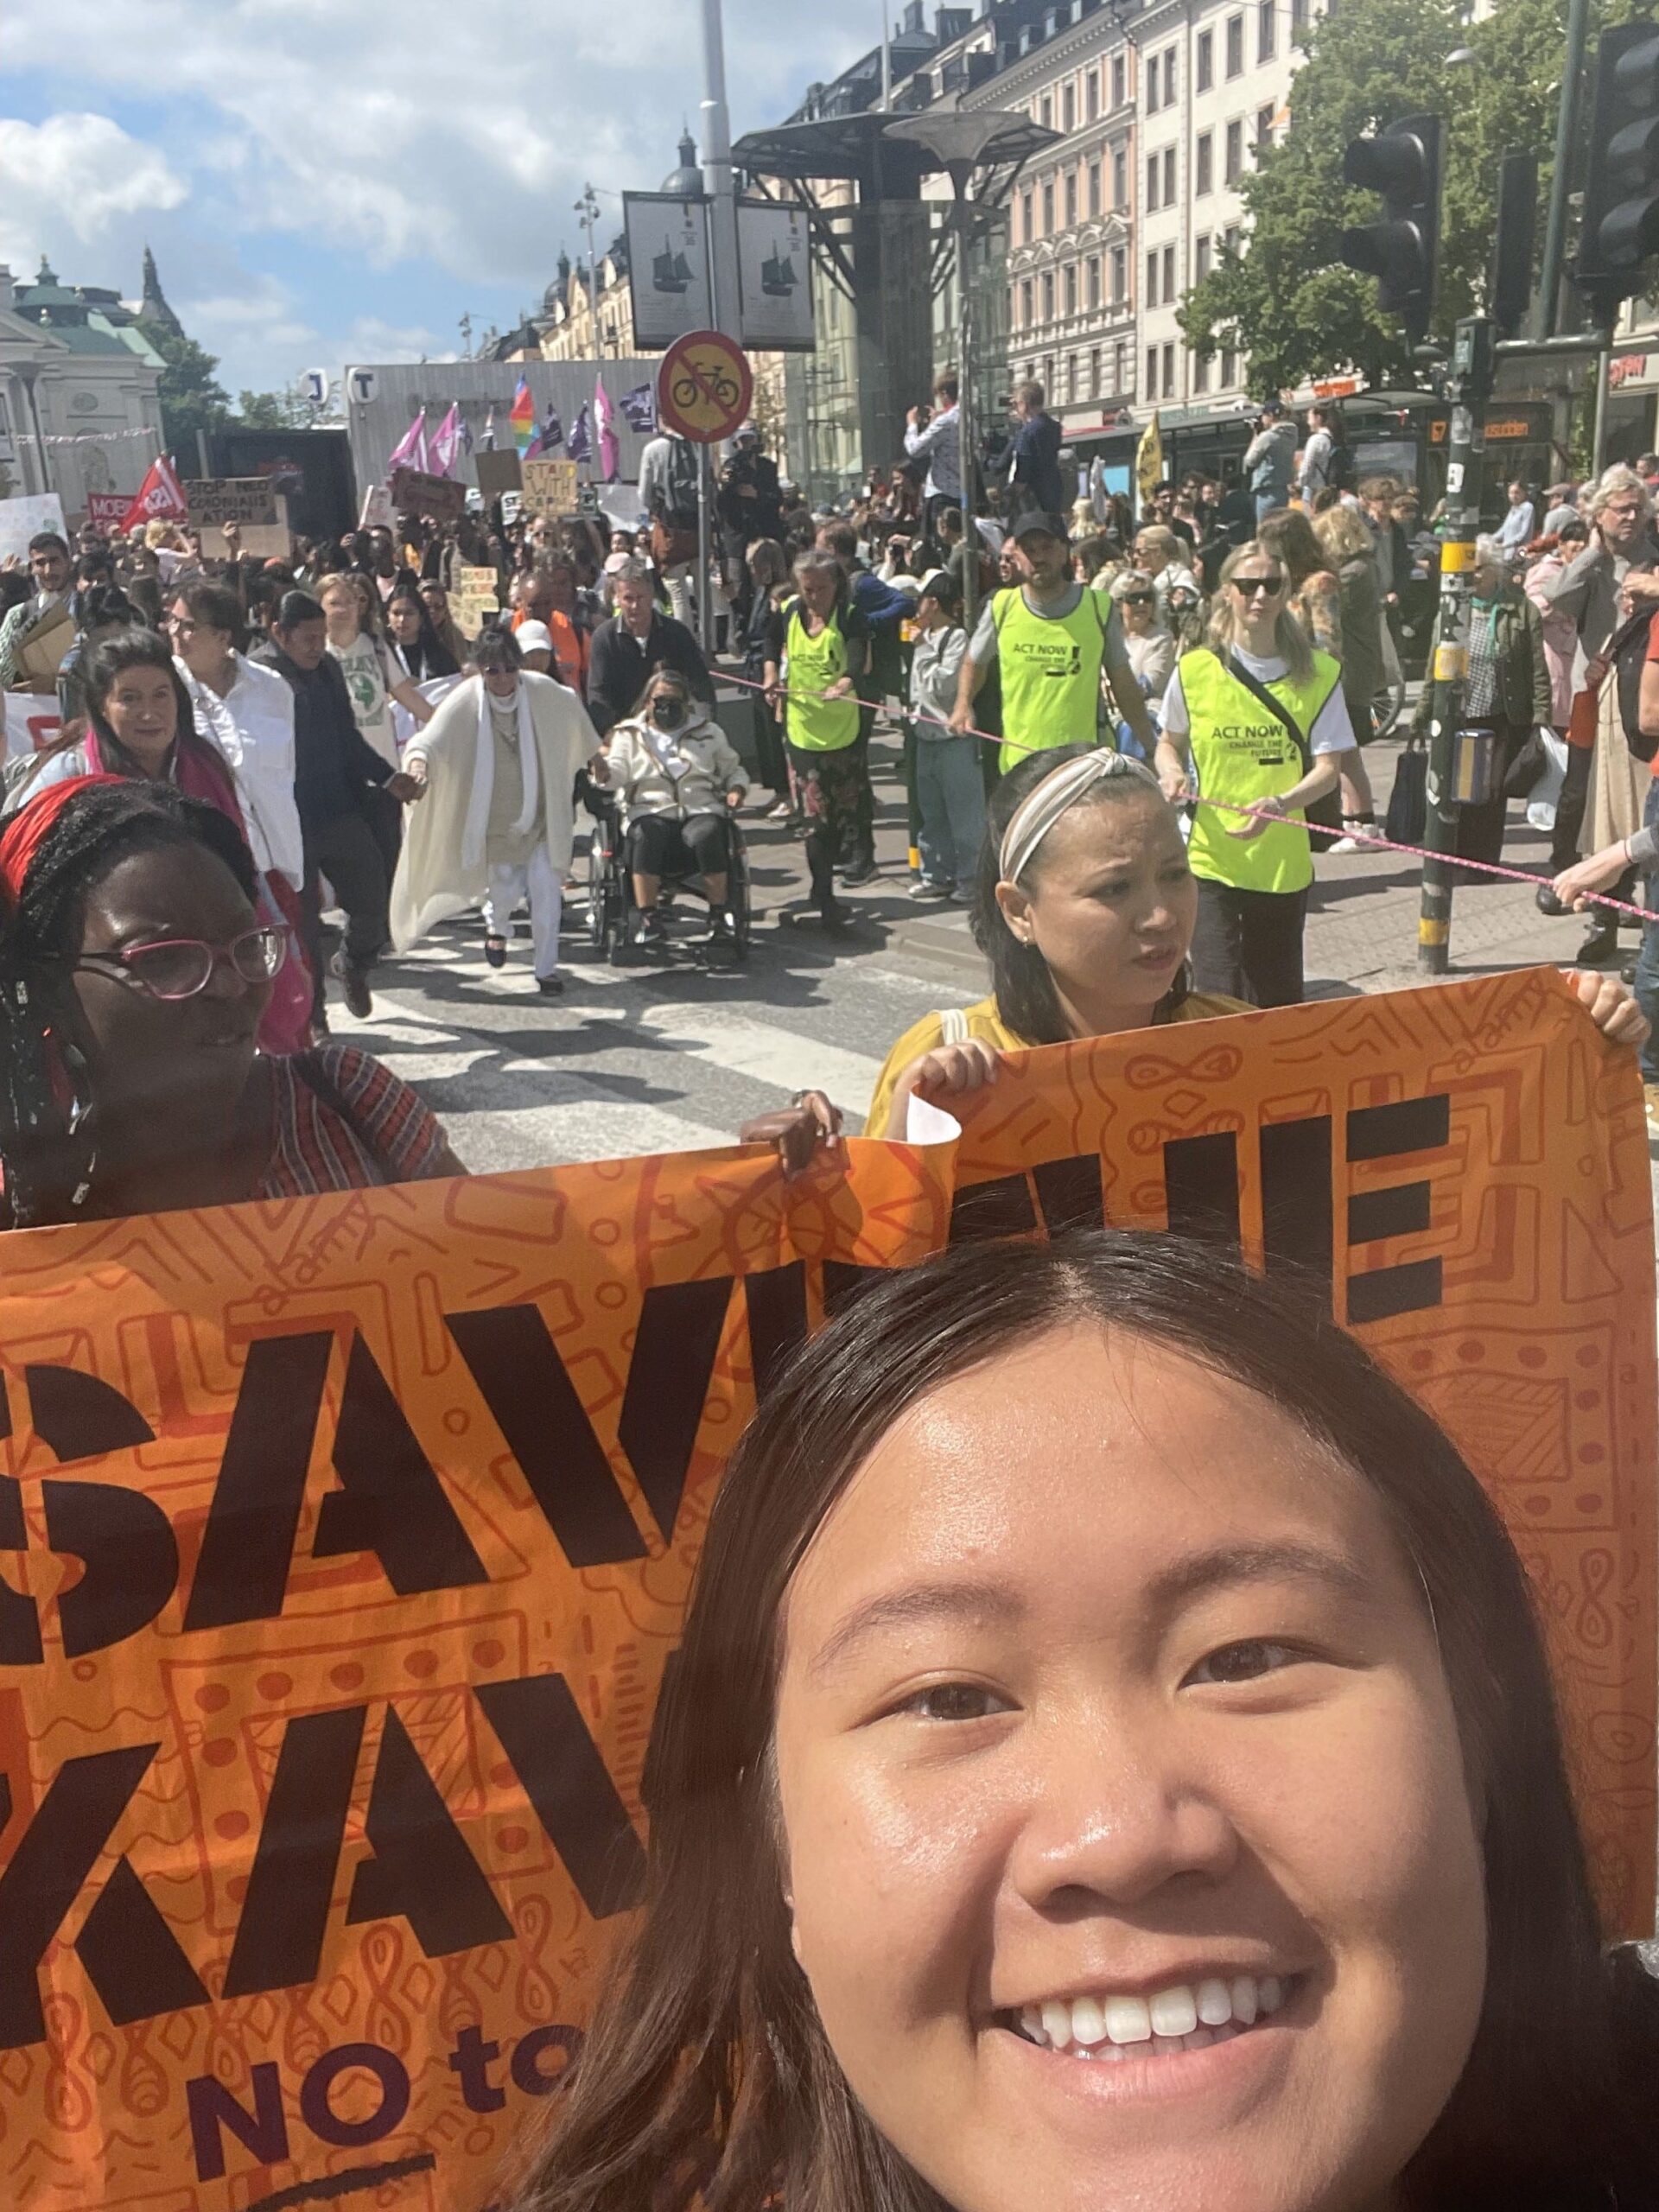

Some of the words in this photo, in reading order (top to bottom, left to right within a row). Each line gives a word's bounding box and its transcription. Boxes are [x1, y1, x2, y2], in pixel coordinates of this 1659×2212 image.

[353, 372, 374, 399] T
[185, 479, 226, 495] STOP
[530, 478, 571, 496] WITH
[201, 509, 252, 524] ATION
[1013, 643, 1035, 653] ACT
[1038, 645, 1068, 655] NOW
[1211, 727, 1240, 739] ACT
[1245, 726, 1283, 738] NOW
[0, 1258, 907, 1665] SAV
[185, 2042, 411, 2183] NO
[448, 2024, 591, 2114] to
